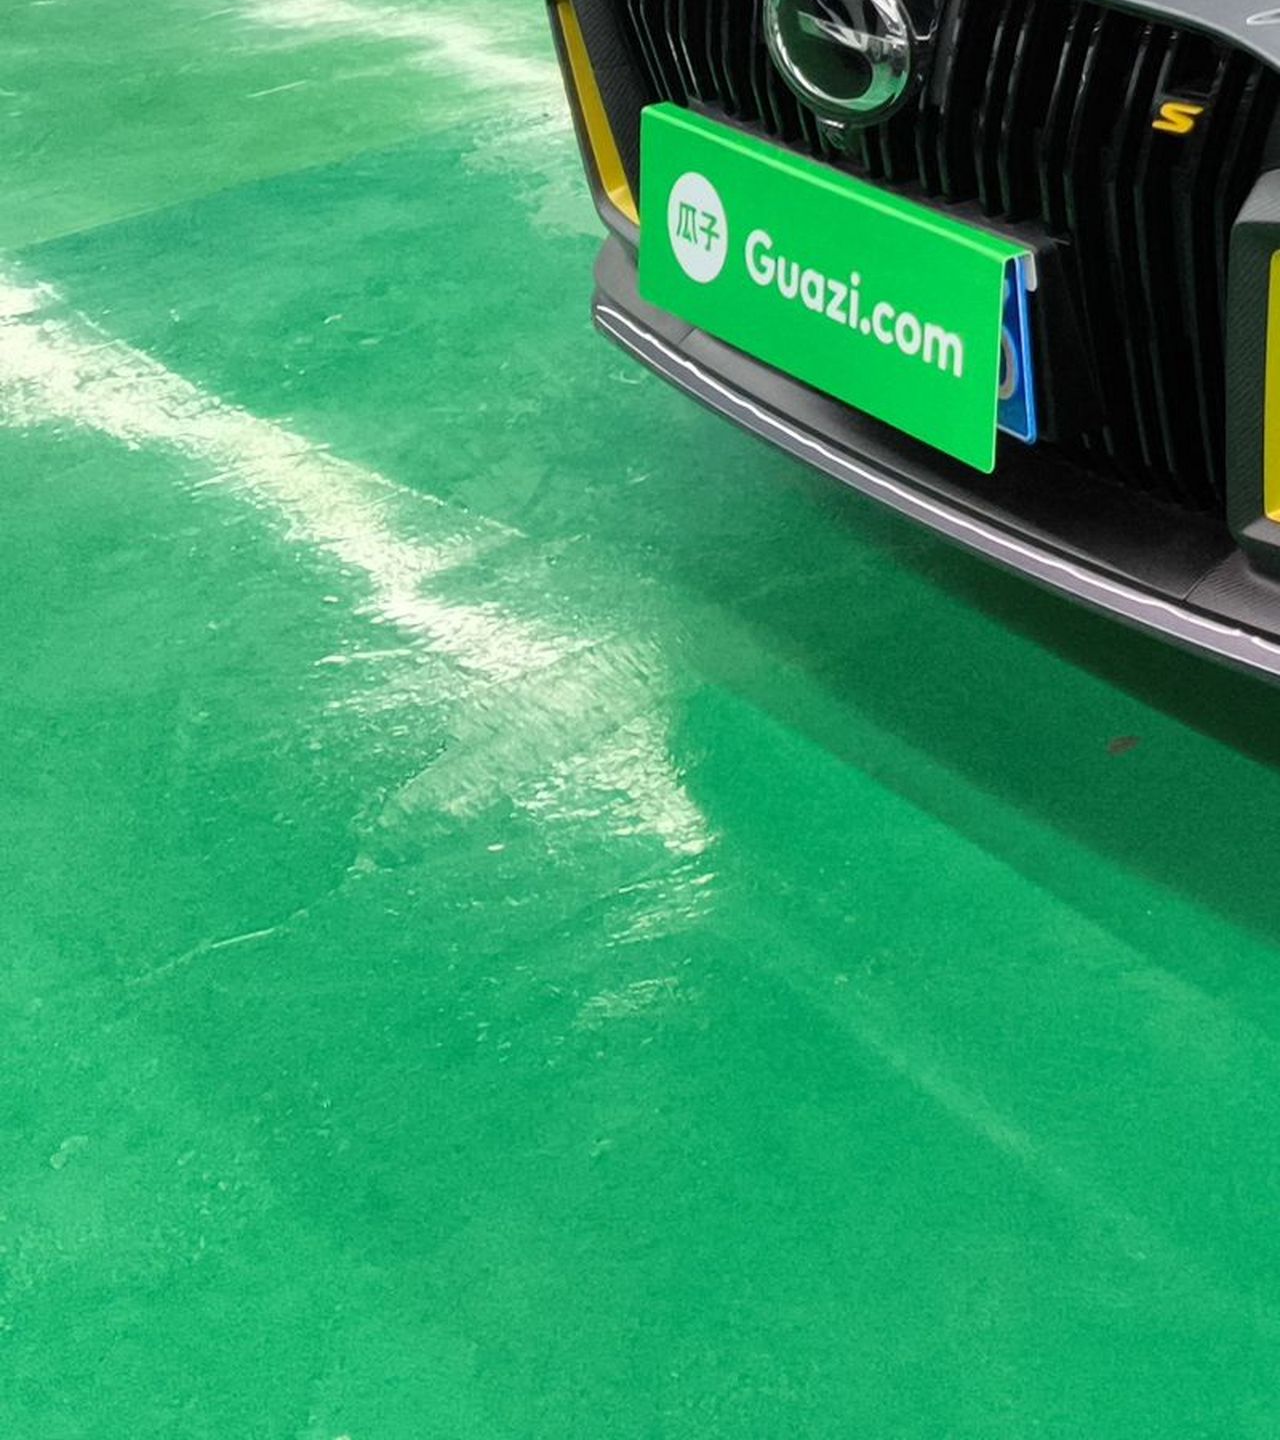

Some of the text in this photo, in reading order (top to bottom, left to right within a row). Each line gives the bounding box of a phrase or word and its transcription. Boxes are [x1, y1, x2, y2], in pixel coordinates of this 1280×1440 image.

[1152, 102, 1204, 134] S
[676, 201, 720, 251] 瓜子
[744, 229, 963, 378] Guazi.com
